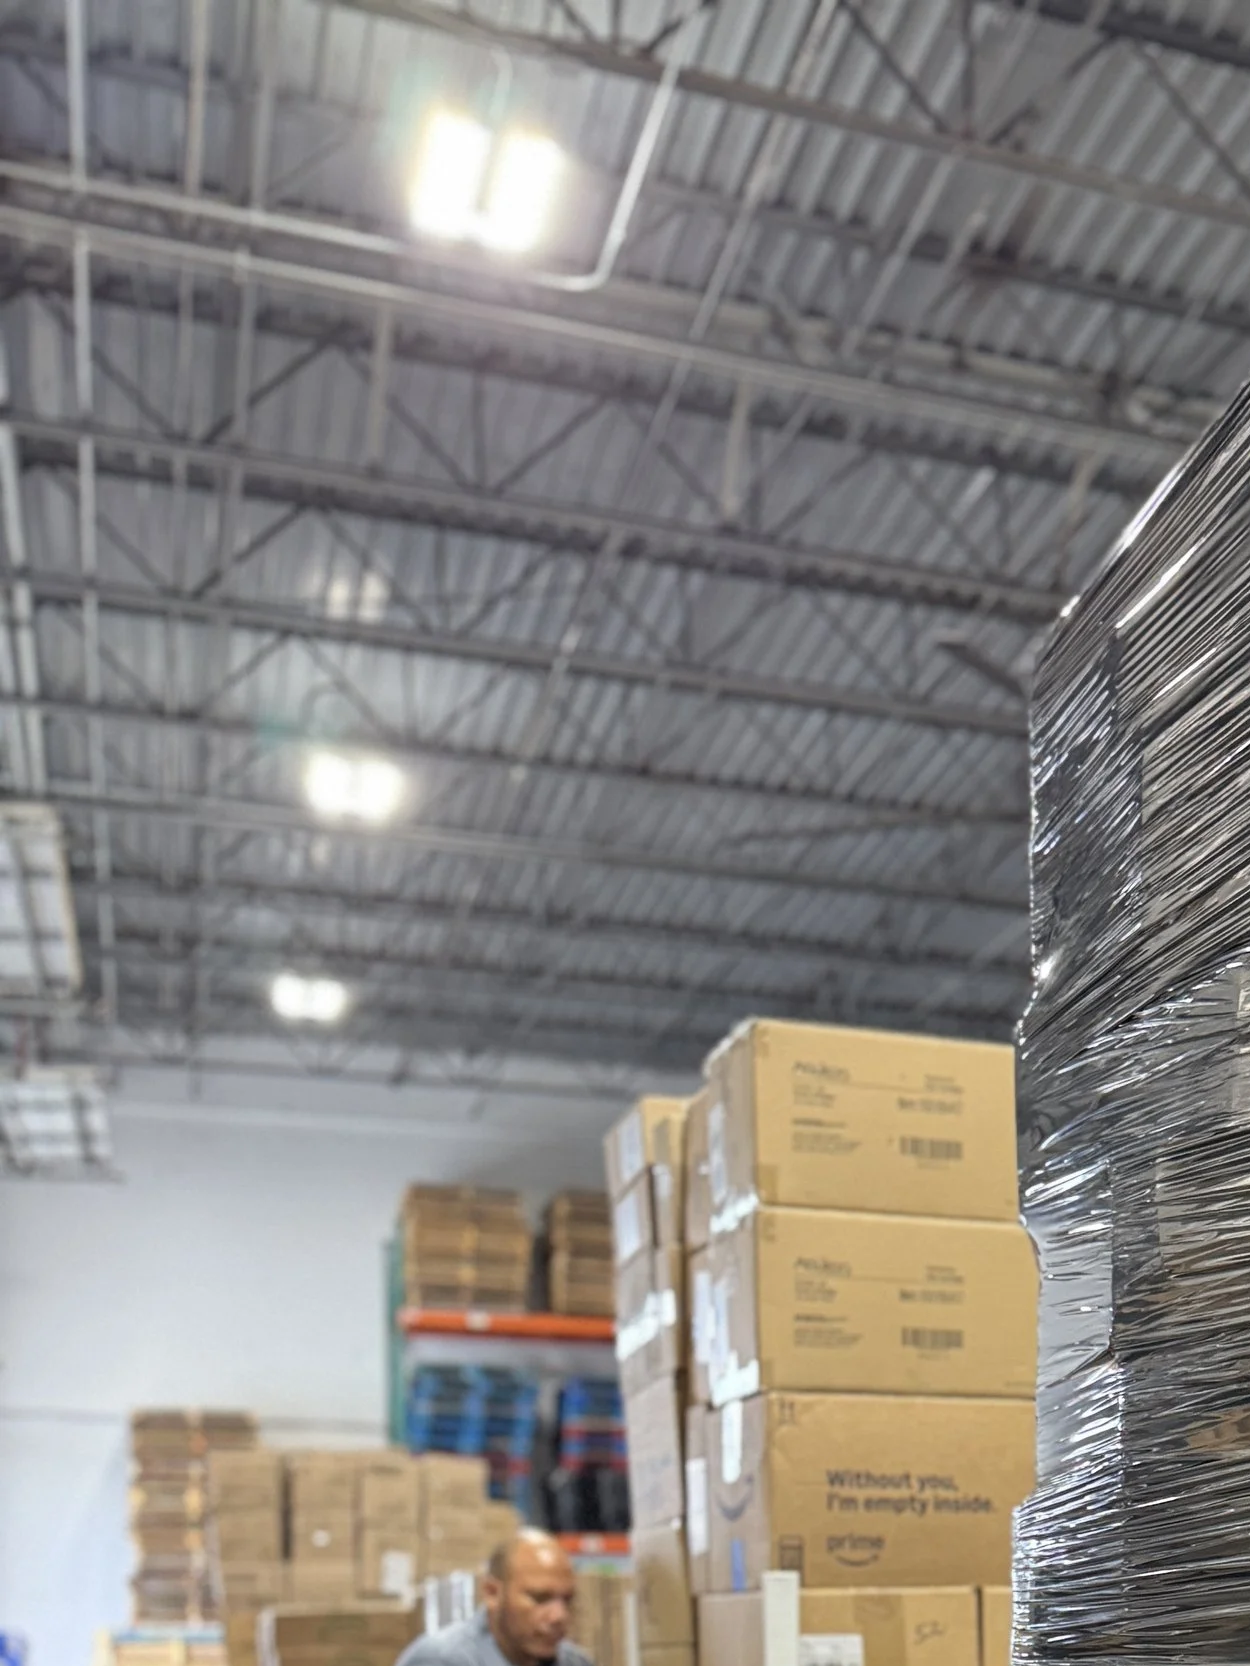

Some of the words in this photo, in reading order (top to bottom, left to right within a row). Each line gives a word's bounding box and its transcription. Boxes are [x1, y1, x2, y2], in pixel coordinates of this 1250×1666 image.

[827, 1470, 911, 1489] Without
[917, 1475, 958, 1493] you,
[827, 1493, 858, 1511] I'm
[864, 1497, 927, 1517] empty
[934, 1495, 997, 1513] inside.
[827, 1534, 885, 1553] prime
